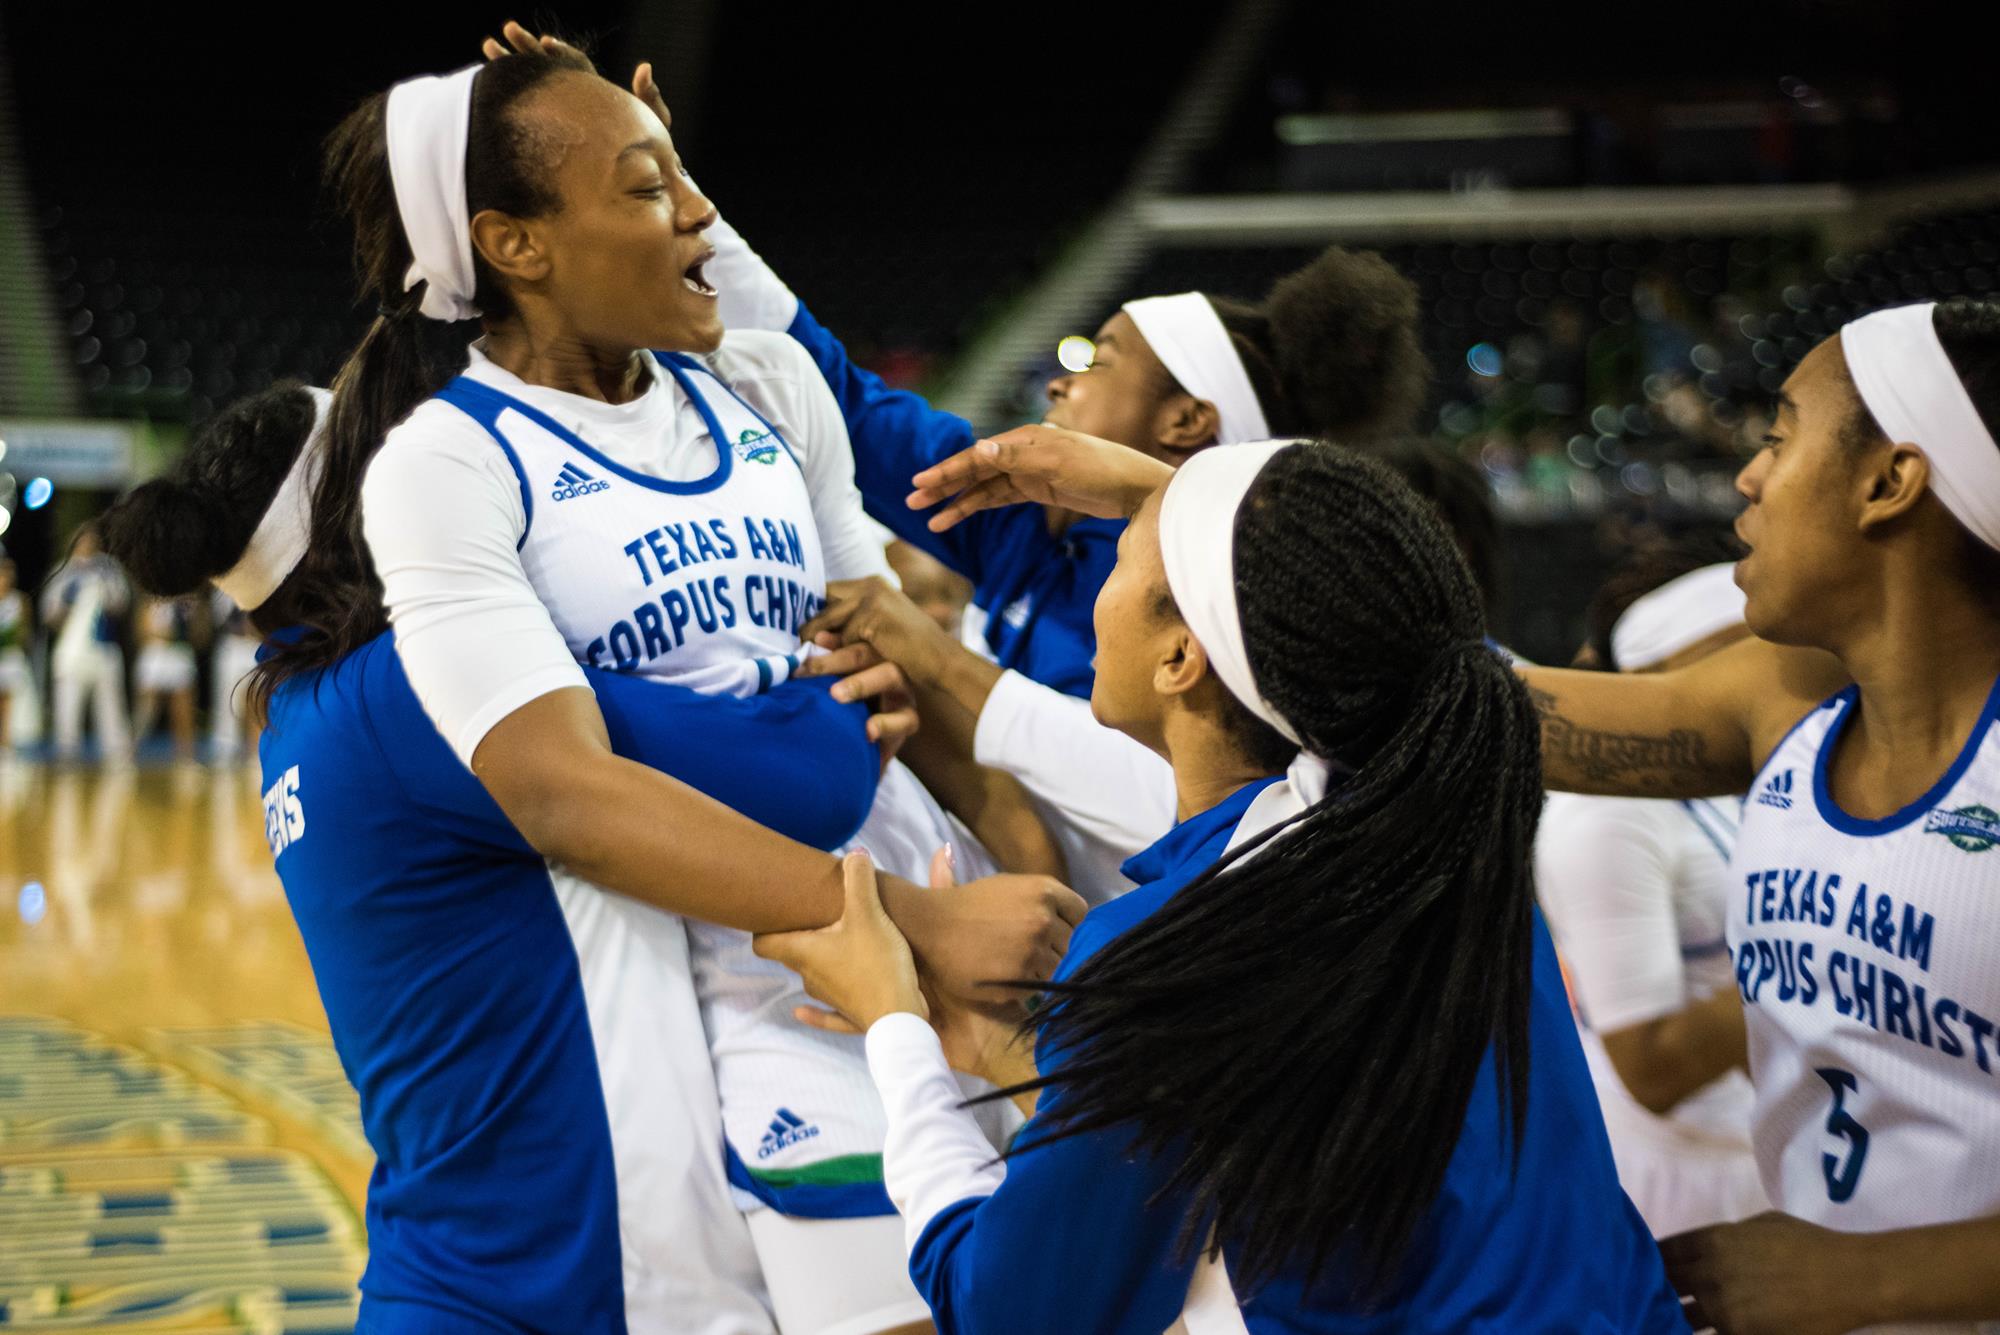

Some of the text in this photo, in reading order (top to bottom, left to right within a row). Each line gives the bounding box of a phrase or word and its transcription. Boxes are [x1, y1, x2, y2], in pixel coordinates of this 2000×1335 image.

[552, 480, 610, 501] adidas
[624, 516, 805, 586] TEXAS A&M
[587, 576, 736, 672] CORPUS
[1747, 869, 1935, 972] TEXAS A&M
[1728, 940, 2000, 1074] RPUS CHRIST
[757, 1125, 820, 1159] adidas
[1815, 1067, 1869, 1203] 5
